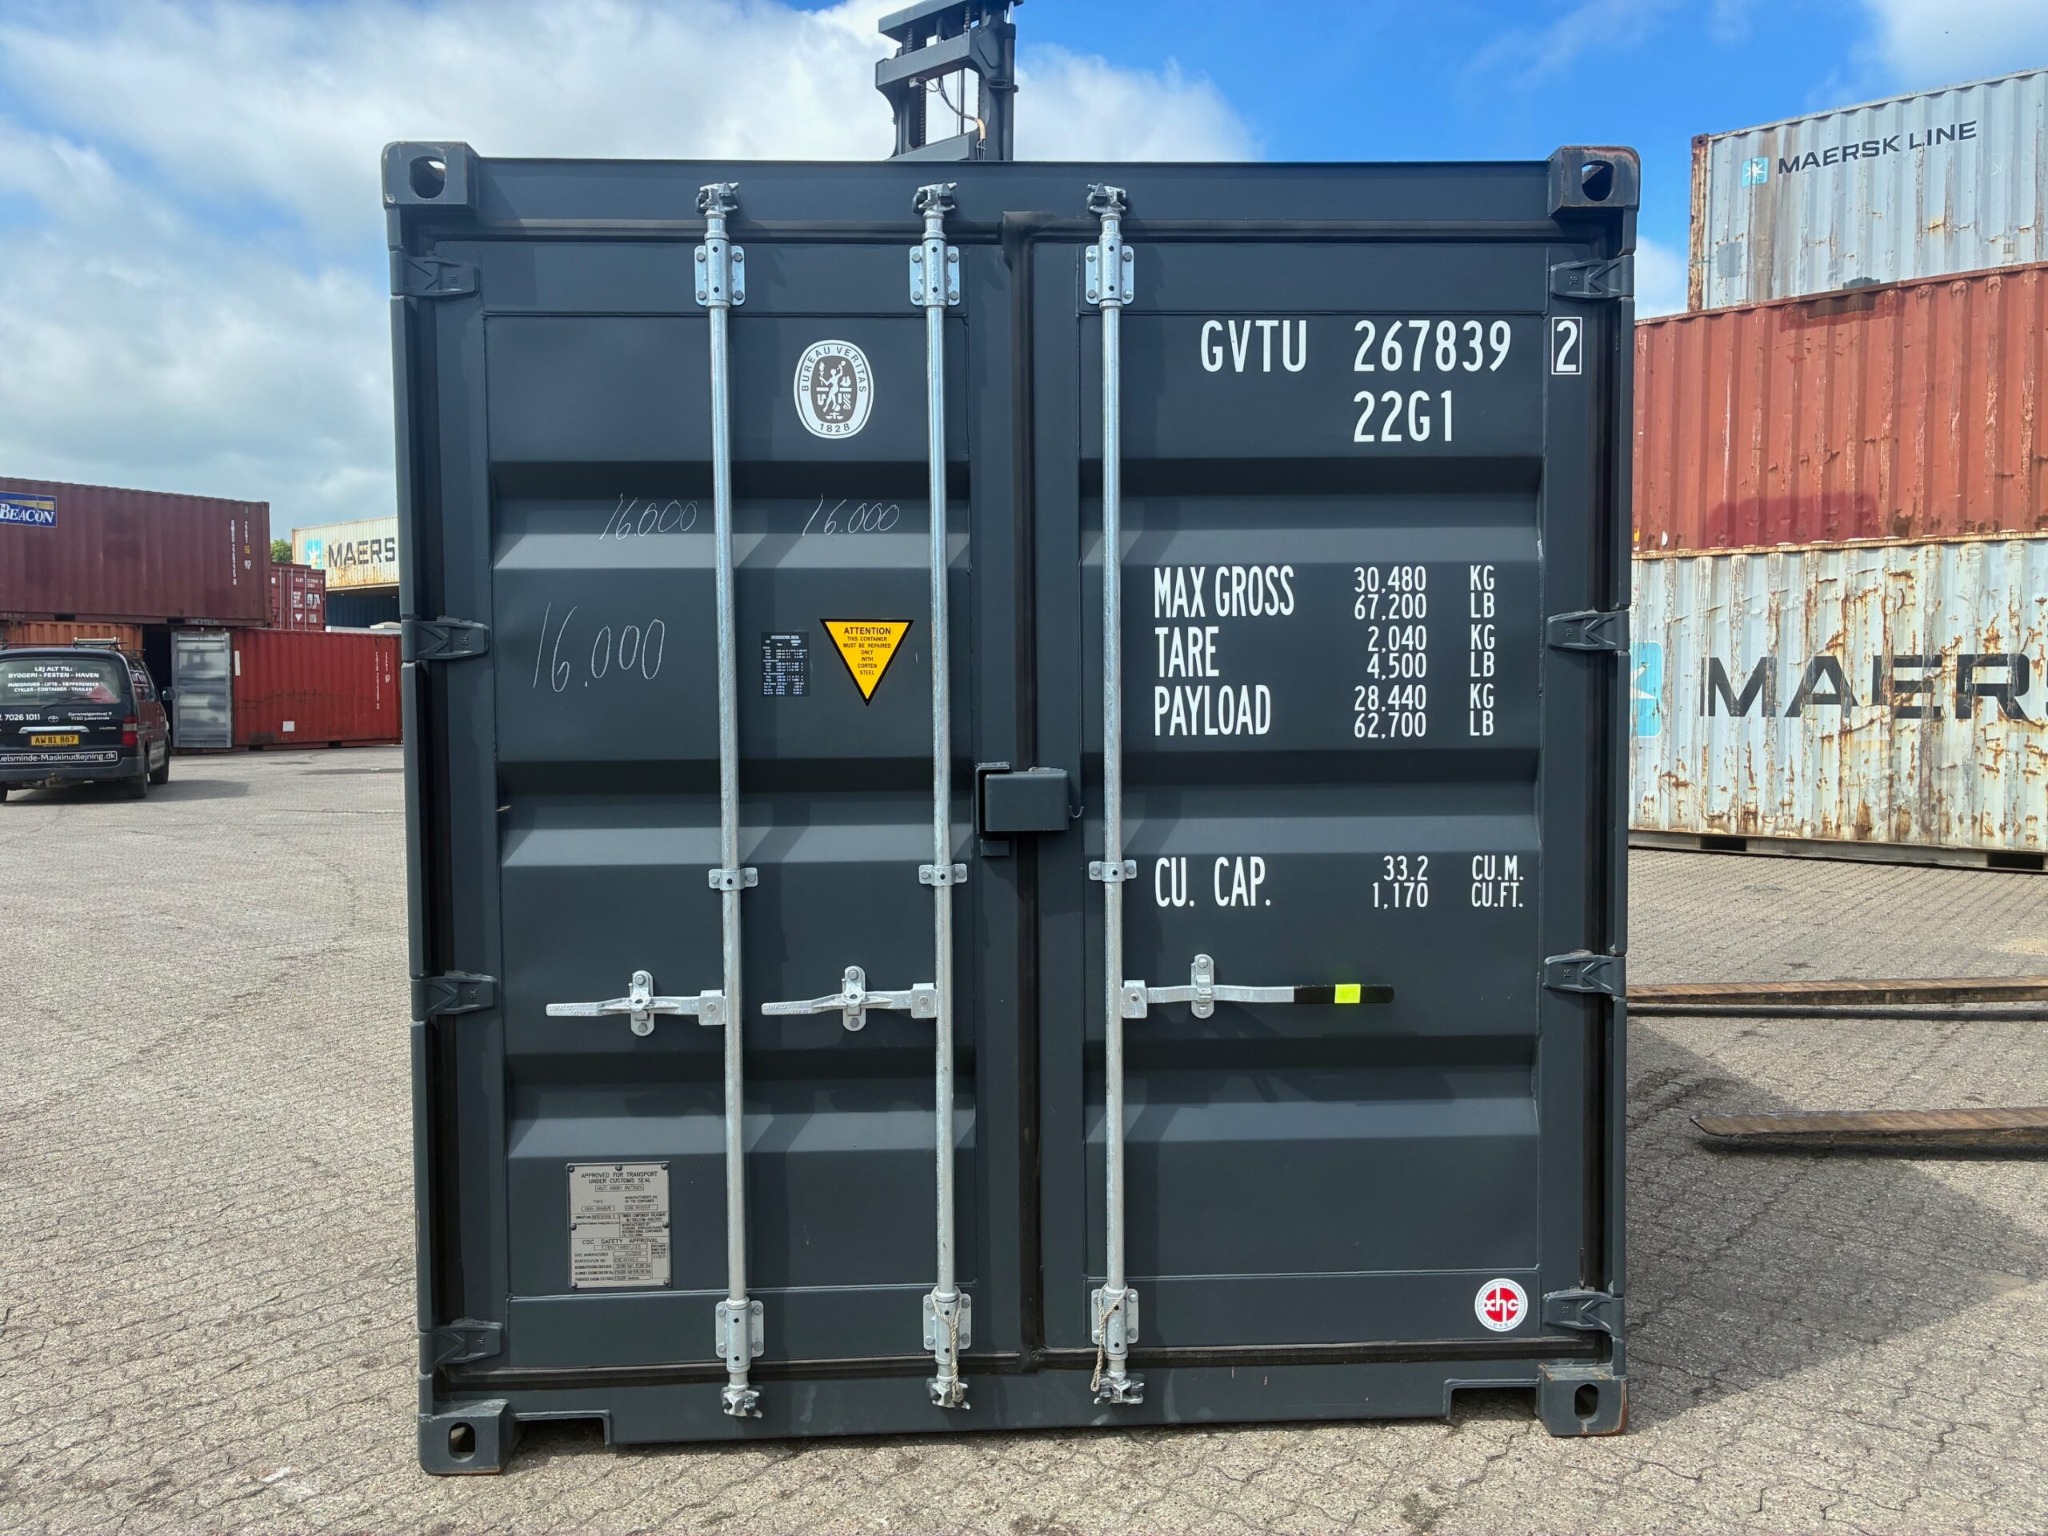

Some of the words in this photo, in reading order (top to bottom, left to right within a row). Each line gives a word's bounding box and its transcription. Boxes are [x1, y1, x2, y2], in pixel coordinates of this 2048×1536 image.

[1778, 135, 1900, 175] MAERSK
[1909, 120, 1977, 150] LINE
[1201, 319, 1307, 373] GVTU
[1354, 319, 1511, 372] 267839
[1555, 319, 1579, 373] 2
[802, 346, 830, 391] BUREAU
[836, 347, 866, 392] VERITAS
[819, 424, 850, 432] 1828
[1354, 390, 1453, 443] 22G1
[599, 492, 698, 540] 16.000
[802, 493, 900, 537] 16.000
[1154, 566, 1205, 619] MAX
[1215, 566, 1295, 617] GROSS
[1354, 566, 1426, 593] 30,480
[1470, 565, 1495, 591] KG
[1354, 593, 1427, 621] 67,200
[1470, 592, 1495, 618] LB
[532, 601, 666, 692] 16.000
[844, 627, 891, 635] ATTENTION
[1155, 626, 1219, 678] TARE
[1368, 625, 1427, 653] 2,040
[1470, 624, 1495, 650] KG
[1367, 652, 1427, 680] 4,500
[1470, 651, 1495, 678] LB
[1700, 652, 2048, 721] MAER
[1154, 685, 1271, 737] PAYLOAD
[1354, 684, 1426, 712] 28,440
[1470, 683, 1494, 709] KG
[1354, 711, 1426, 739] 62,700
[1470, 710, 1494, 736] LB
[1155, 856, 1195, 909] CU.
[1214, 856, 1271, 908] CAP.
[1382, 855, 1429, 882] 33.2
[1471, 855, 1524, 881] CU.M.
[1371, 881, 1429, 910] 1,170
[1471, 882, 1524, 908] CU.FT.
